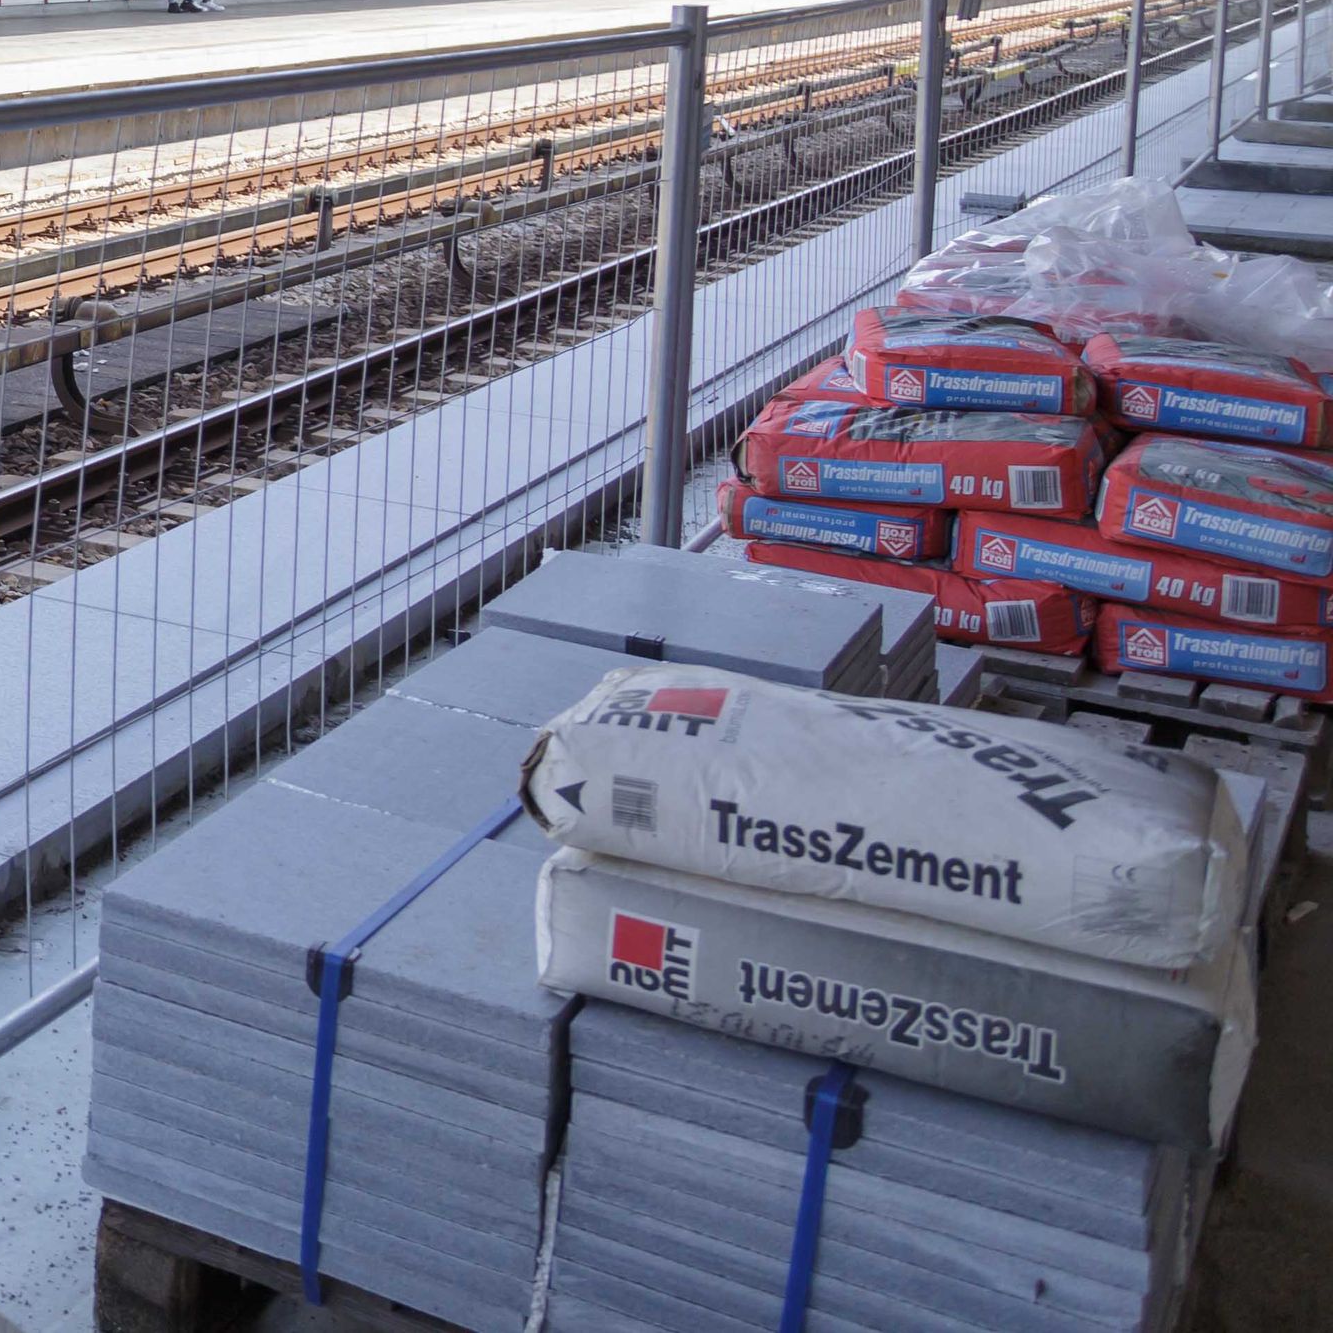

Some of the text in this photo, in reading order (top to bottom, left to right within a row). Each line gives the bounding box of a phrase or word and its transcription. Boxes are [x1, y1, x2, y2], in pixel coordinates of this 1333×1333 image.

[930, 372, 1056, 397] Trassdrainmörtel
[1164, 391, 1299, 426] Trassdrainmörtel
[786, 475, 818, 491] Profi
[823, 464, 937, 485] Trassdrainmörtel
[949, 475, 1004, 499] 40 kg
[1157, 463, 1222, 484] 40 kg
[749, 518, 873, 551] Trassdrainmörtel
[1183, 506, 1331, 553] Trassdrainmörtel
[1020, 544, 1145, 581] Trassdrainmörtel
[1155, 575, 1216, 606] 40 kg
[959, 609, 981, 633] kg
[1174, 632, 1321, 668] Trassdrainmörtel
[708, 798, 1024, 905] TrassZement
[738, 961, 1064, 1083] TrassZement
